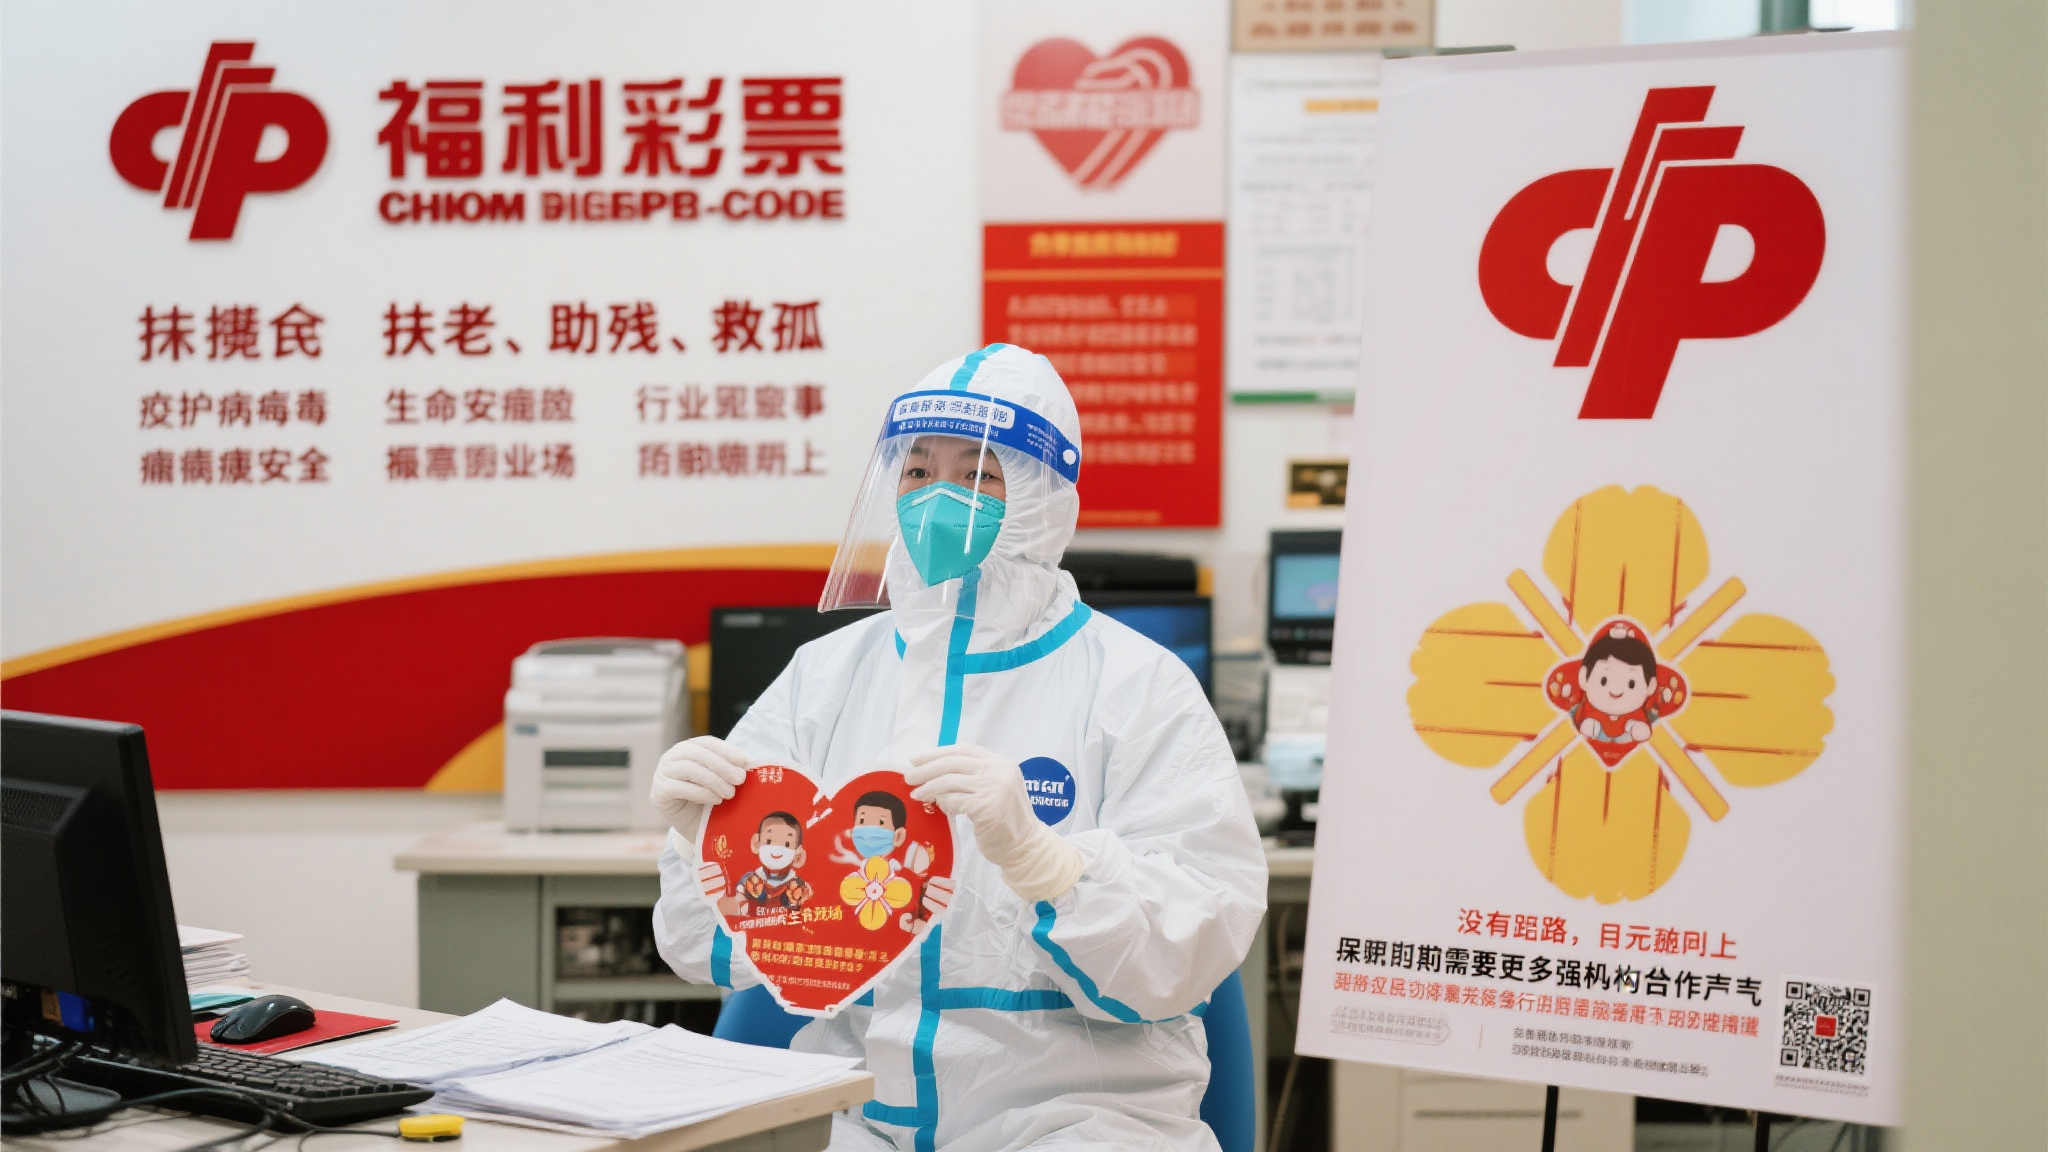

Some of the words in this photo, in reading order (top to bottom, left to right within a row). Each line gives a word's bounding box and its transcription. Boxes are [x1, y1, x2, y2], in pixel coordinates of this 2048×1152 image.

[377, 76, 844, 179] 福利彩票
[384, 300, 825, 356] 扶老、助残、救孤
